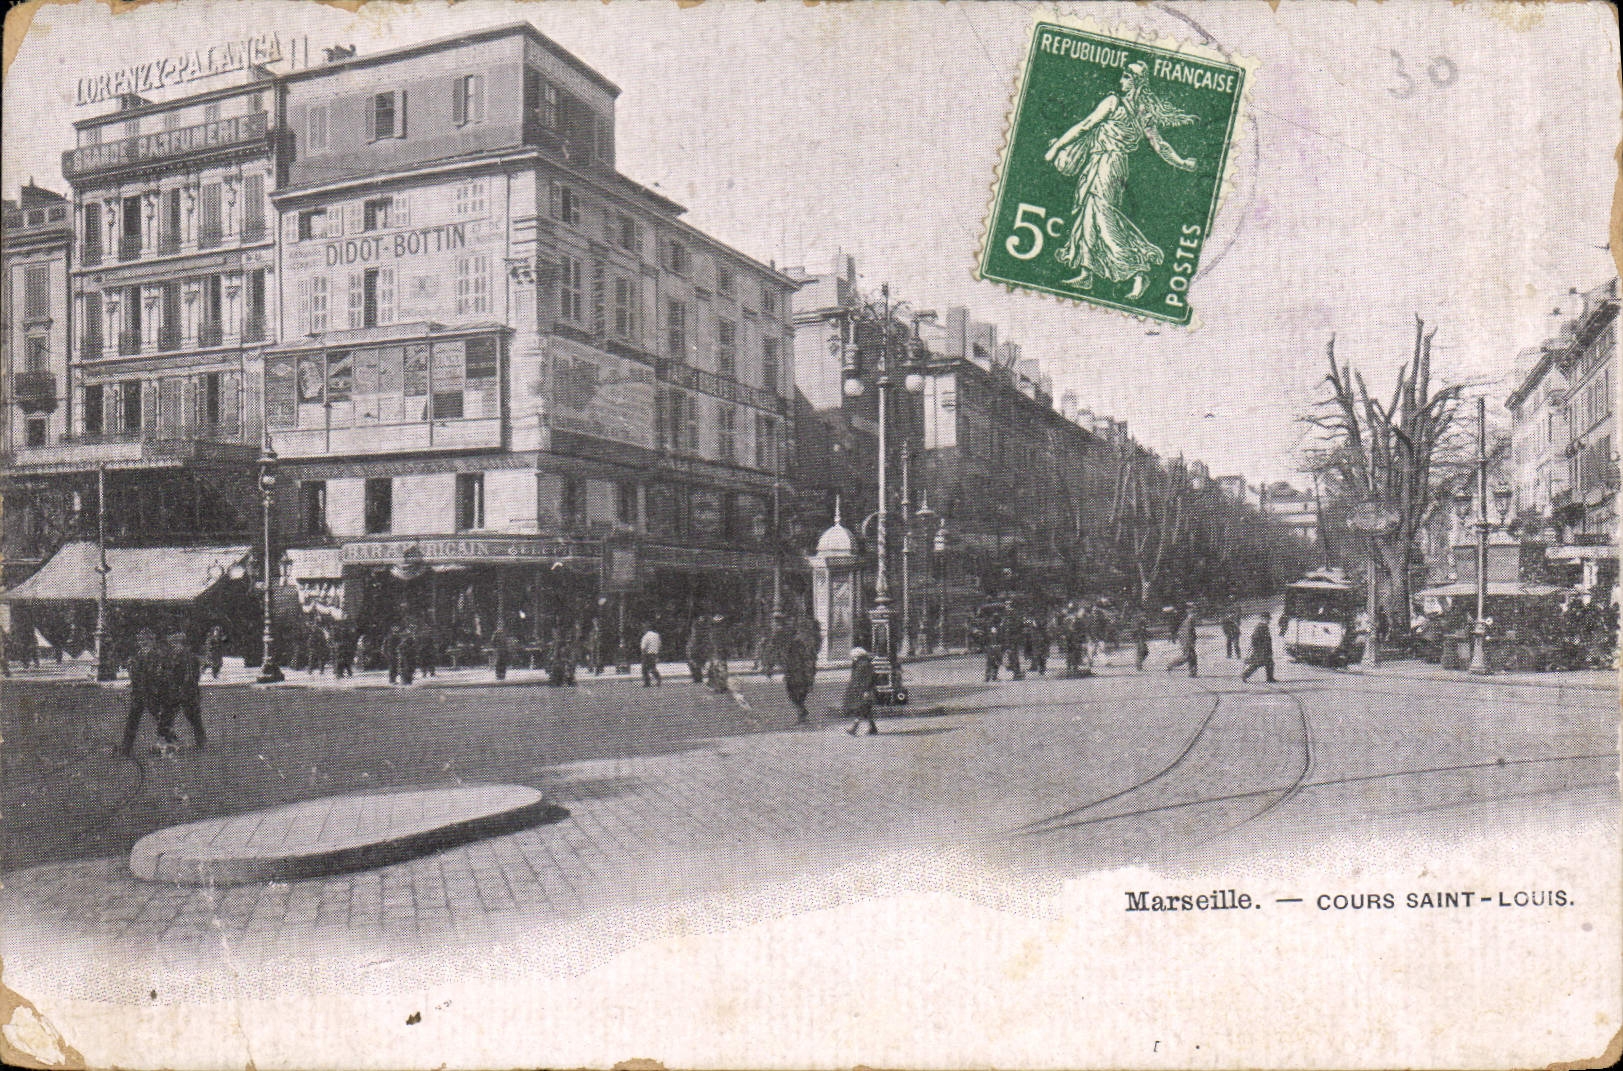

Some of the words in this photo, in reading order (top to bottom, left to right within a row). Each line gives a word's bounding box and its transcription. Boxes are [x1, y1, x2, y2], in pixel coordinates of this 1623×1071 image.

[1154, 59, 1235, 93] FRANÇAISE
[326, 223, 465, 267] DIDOT-BOTTIN
[1165, 224, 1201, 307] POSTES
